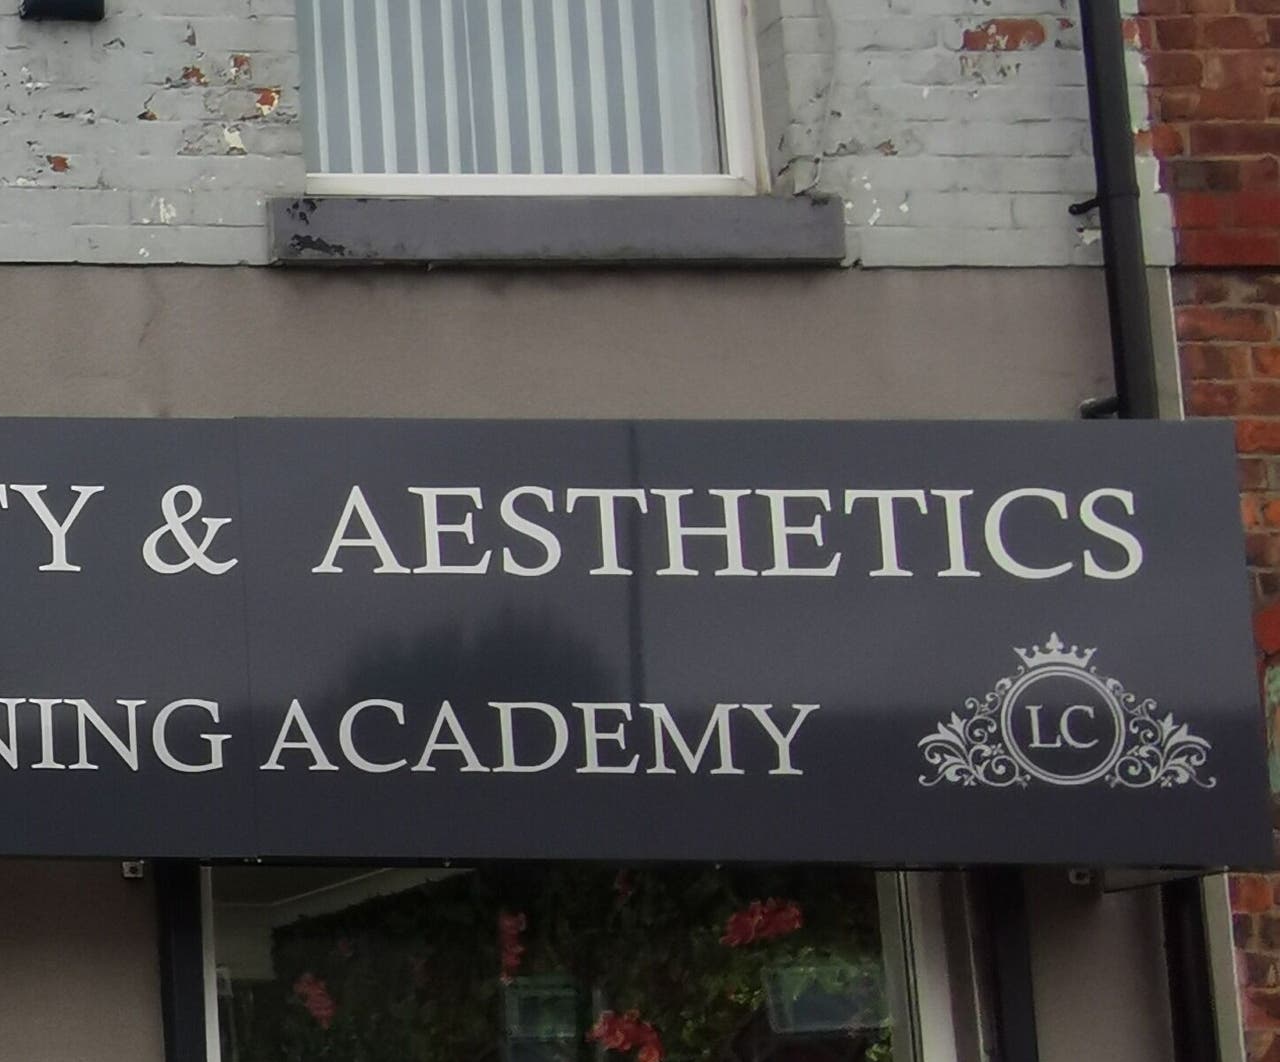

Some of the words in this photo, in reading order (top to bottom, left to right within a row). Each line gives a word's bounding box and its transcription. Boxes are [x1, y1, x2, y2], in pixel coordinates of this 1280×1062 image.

[143, 484, 239, 575] &
[312, 486, 1143, 580] AESTHETICS
[260, 698, 820, 775] ACADEMY
[1025, 704, 1098, 749] LC
